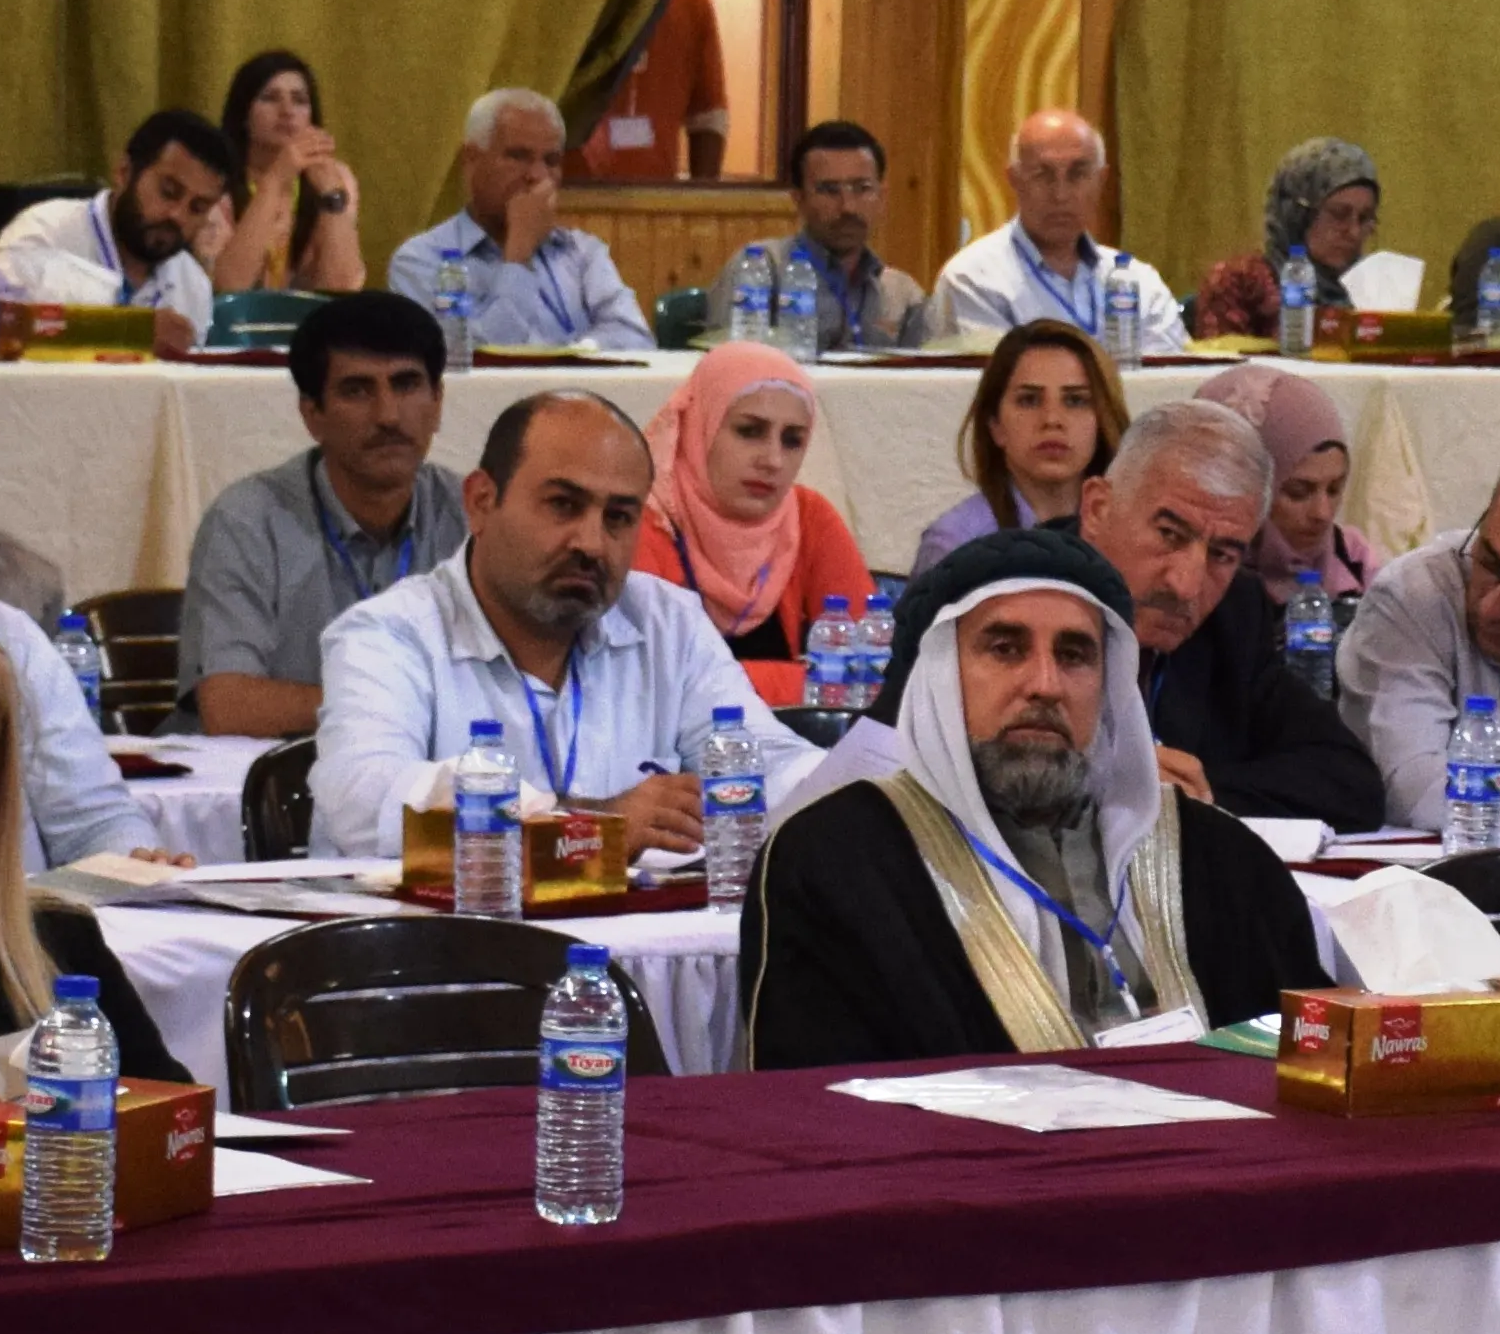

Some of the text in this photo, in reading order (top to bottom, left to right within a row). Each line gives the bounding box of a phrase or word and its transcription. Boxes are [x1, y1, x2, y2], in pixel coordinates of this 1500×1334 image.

[1293, 1016, 1331, 1042] Nawras
[568, 1054, 614, 1069] Tiyan
[1371, 1034, 1428, 1062] Nawras
[164, 1125, 205, 1159] Nawras
